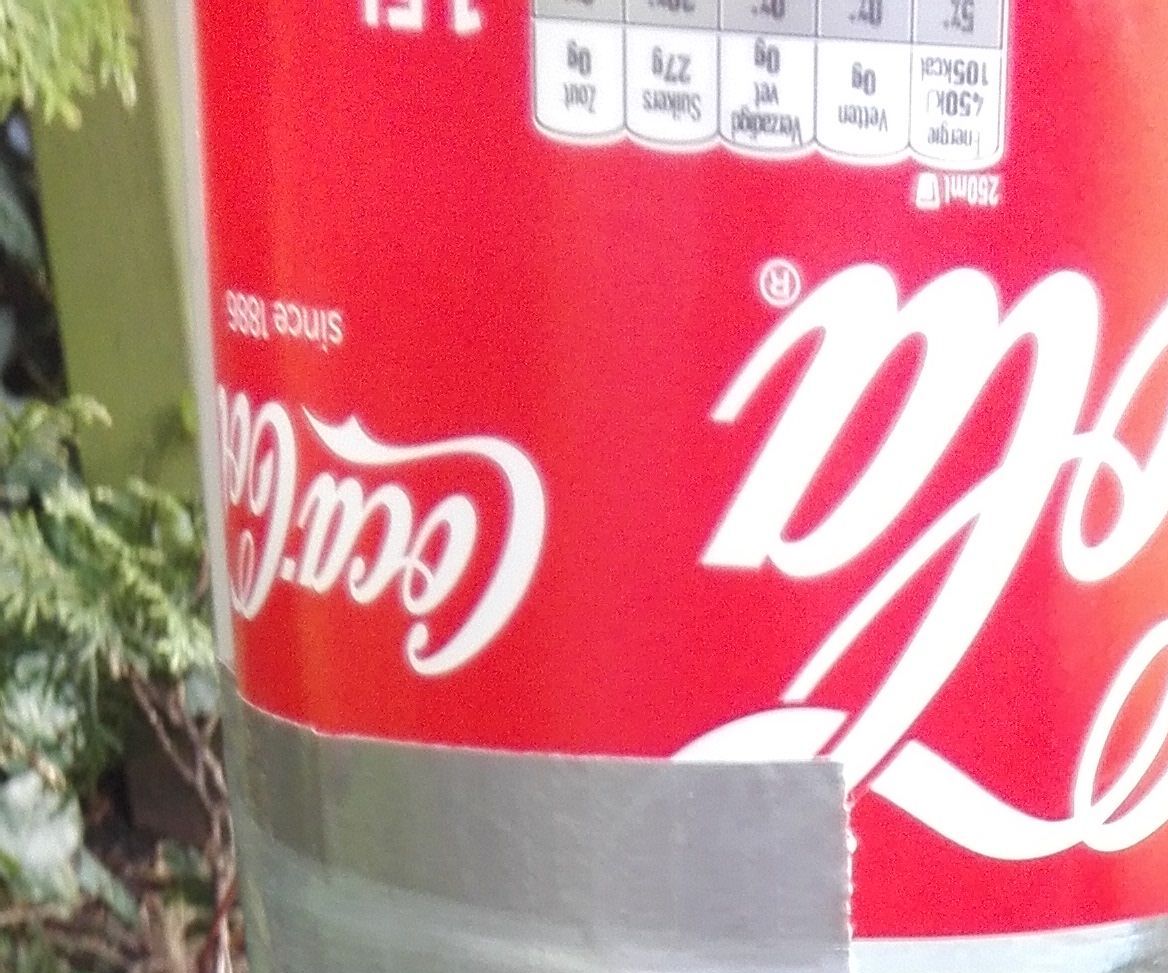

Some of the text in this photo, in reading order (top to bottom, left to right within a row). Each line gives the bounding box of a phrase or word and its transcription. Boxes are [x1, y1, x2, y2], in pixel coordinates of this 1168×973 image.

[566, 39, 592, 75] 0g
[651, 45, 691, 84] 27g
[753, 37, 780, 74] 0g
[920, 56, 989, 87] 105kcal
[851, 62, 877, 96] 0g
[563, 81, 597, 114] Zout
[642, 88, 702, 122] Suikers
[837, 104, 889, 133] Vetten
[943, 174, 1000, 206] 250ml
[225, 289, 345, 354] since 1886
